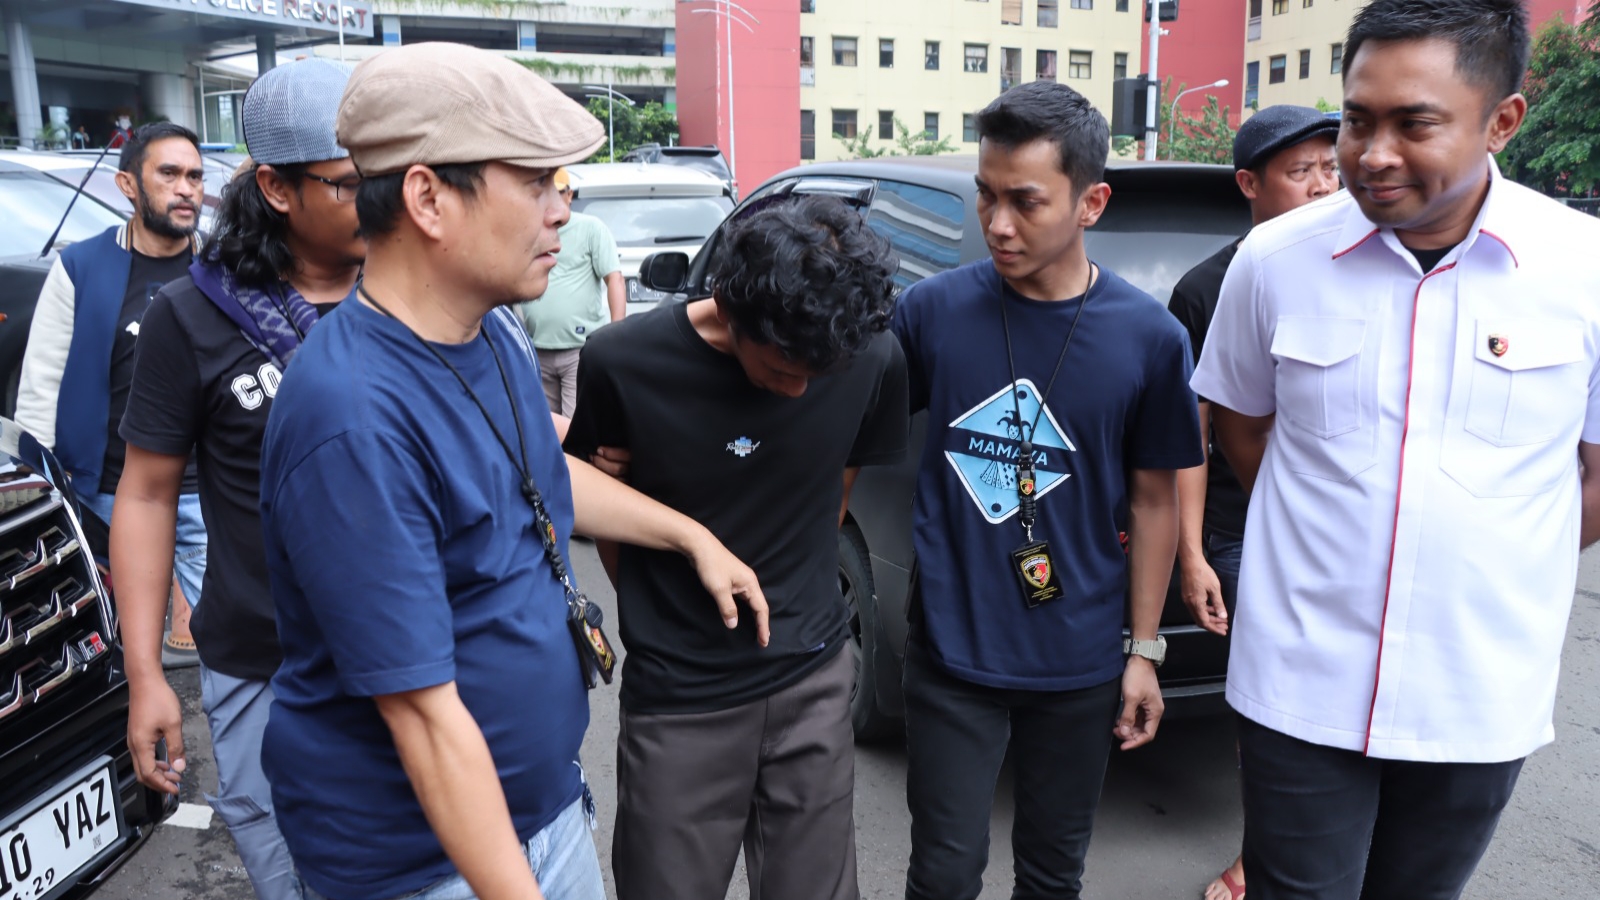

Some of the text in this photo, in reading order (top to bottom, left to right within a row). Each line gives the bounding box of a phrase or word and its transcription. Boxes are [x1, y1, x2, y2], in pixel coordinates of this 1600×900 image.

[192, 0, 367, 28] LICE RESORT
[969, 437, 1048, 466] MAMAA
[53, 778, 110, 849] YAZ
